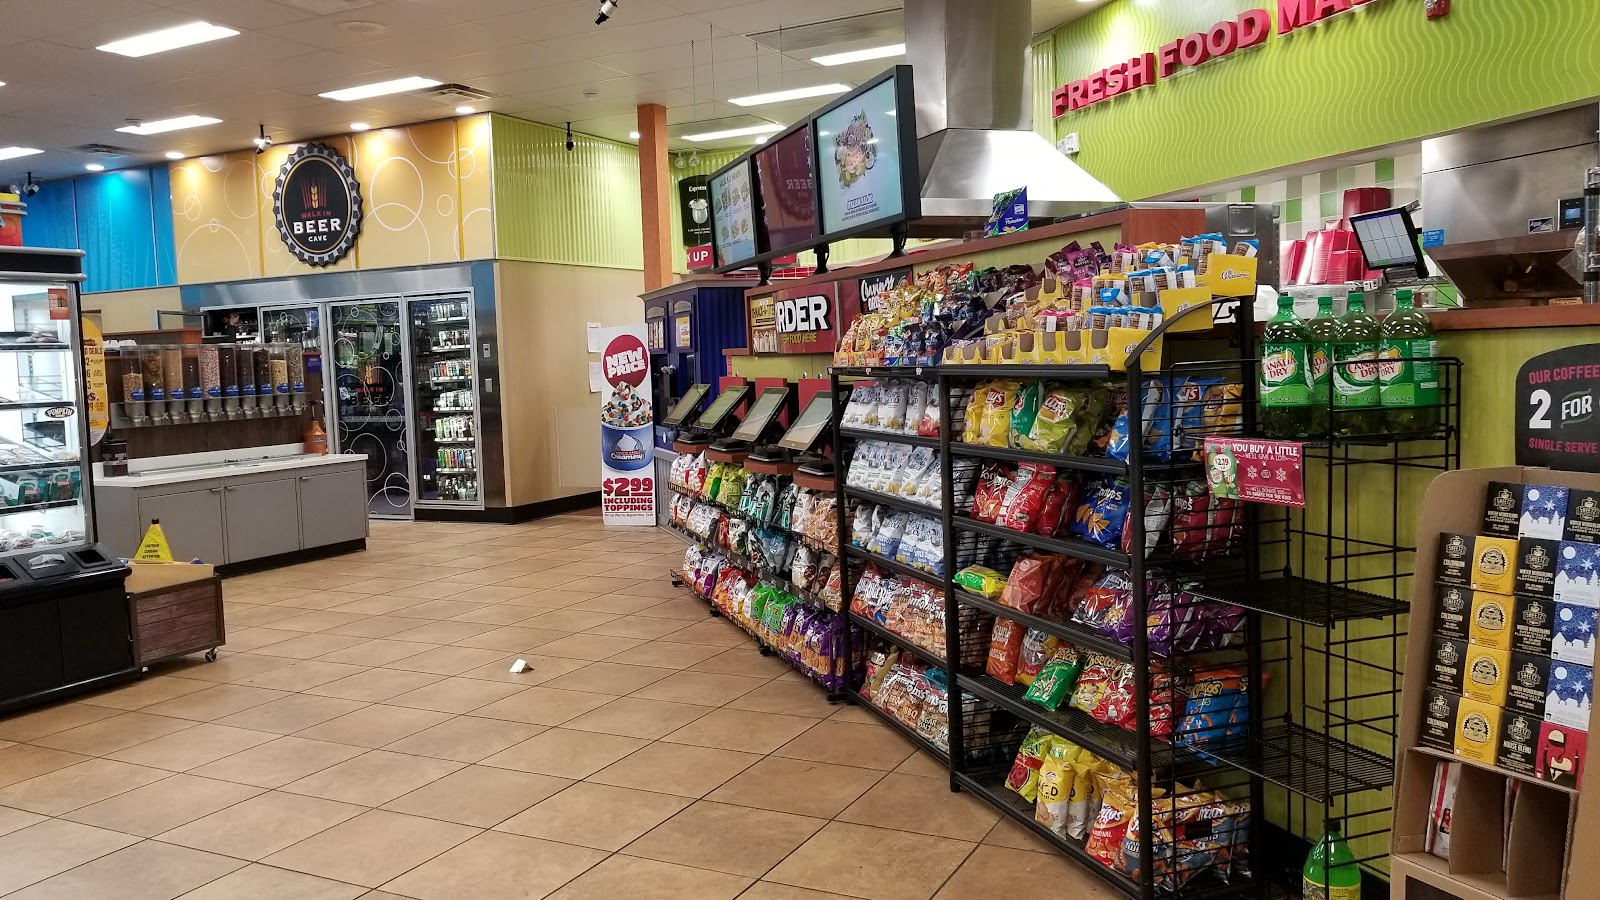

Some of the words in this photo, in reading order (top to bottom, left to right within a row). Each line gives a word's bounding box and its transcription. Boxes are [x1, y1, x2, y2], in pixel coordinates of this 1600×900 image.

[1052, 52, 1155, 118] FRESH
[1159, 8, 1270, 78] FOOD
[301, 211, 320, 219] WALK
[293, 218, 342, 235] BEER
[775, 295, 829, 333] RDER
[606, 347, 642, 368] NEW
[1262, 357, 1297, 374] CANADA
[608, 359, 645, 379] PRICE
[1270, 367, 1288, 378] DRY
[1529, 370, 1551, 384] OUR
[46, 407, 72, 417] PUMPKIN
[1529, 389, 1551, 429] 2
[1562, 395, 1592, 420] FOR
[1232, 443, 1248, 452] YOU
[1250, 444, 1265, 454] BUY
[1267, 446, 1274, 454] A
[1529, 437, 1562, 451] SINGLE
[1565, 442, 1598, 453] SERVE
[1517, 744, 1531, 754] BLEND
